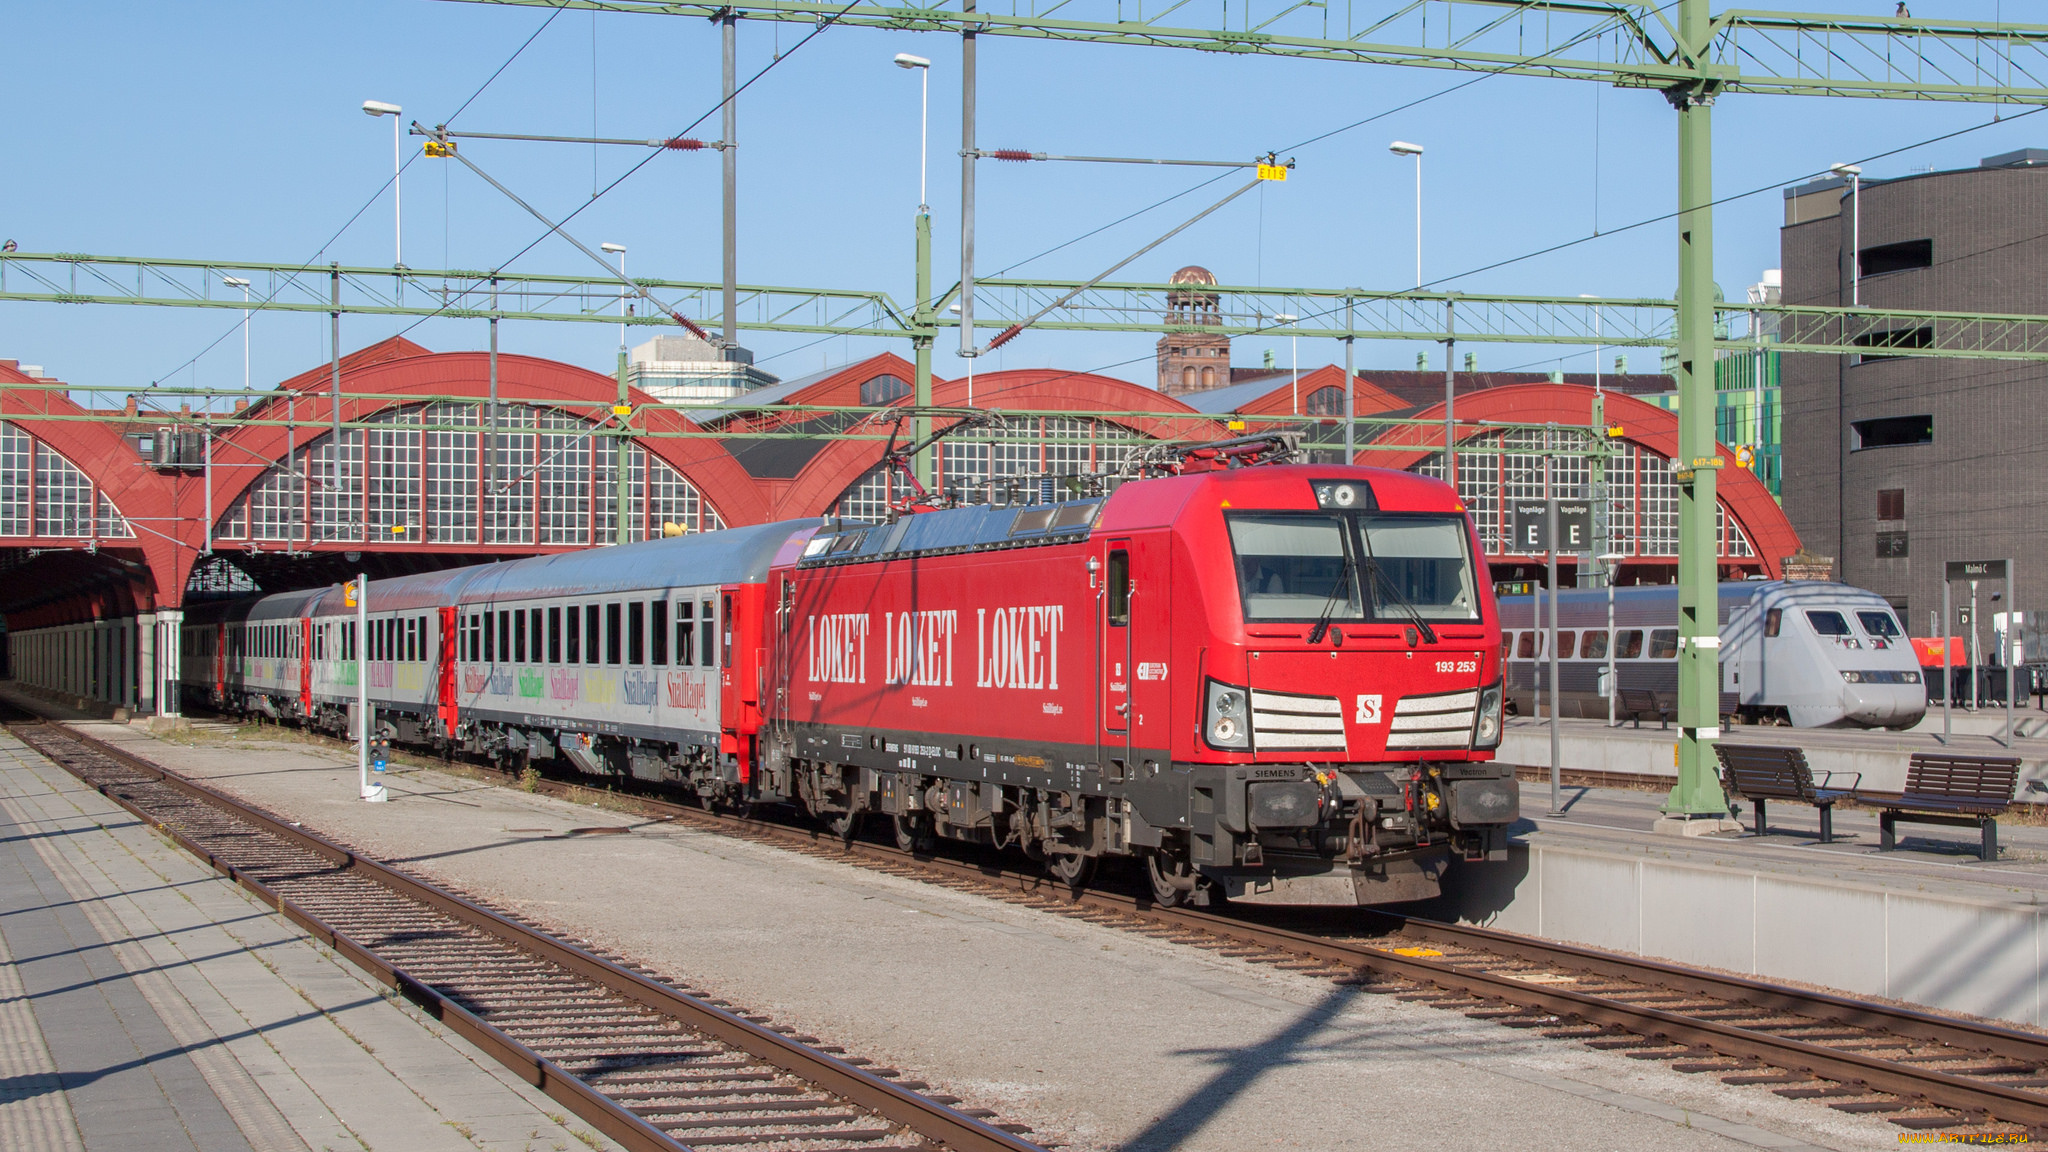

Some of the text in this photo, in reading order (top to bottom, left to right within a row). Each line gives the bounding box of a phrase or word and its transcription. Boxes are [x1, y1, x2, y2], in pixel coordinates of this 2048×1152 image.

[1260, 168, 1285, 179] E119
[1519, 506, 1545, 514] Vagnläge
[1560, 506, 1587, 514] Vagnläge
[1528, 525, 1538, 544] E
[1569, 525, 1580, 544] E
[1965, 564, 1987, 574] Malmö C
[1961, 614, 1968, 623] D
[808, 605, 1063, 690] LOKET LOKET LOKET
[1435, 661, 1476, 672] 193 253
[623, 670, 658, 713] Snälltåget
[667, 672, 706, 717] Snälltåget
[1138, 714, 1143, 725] 2
